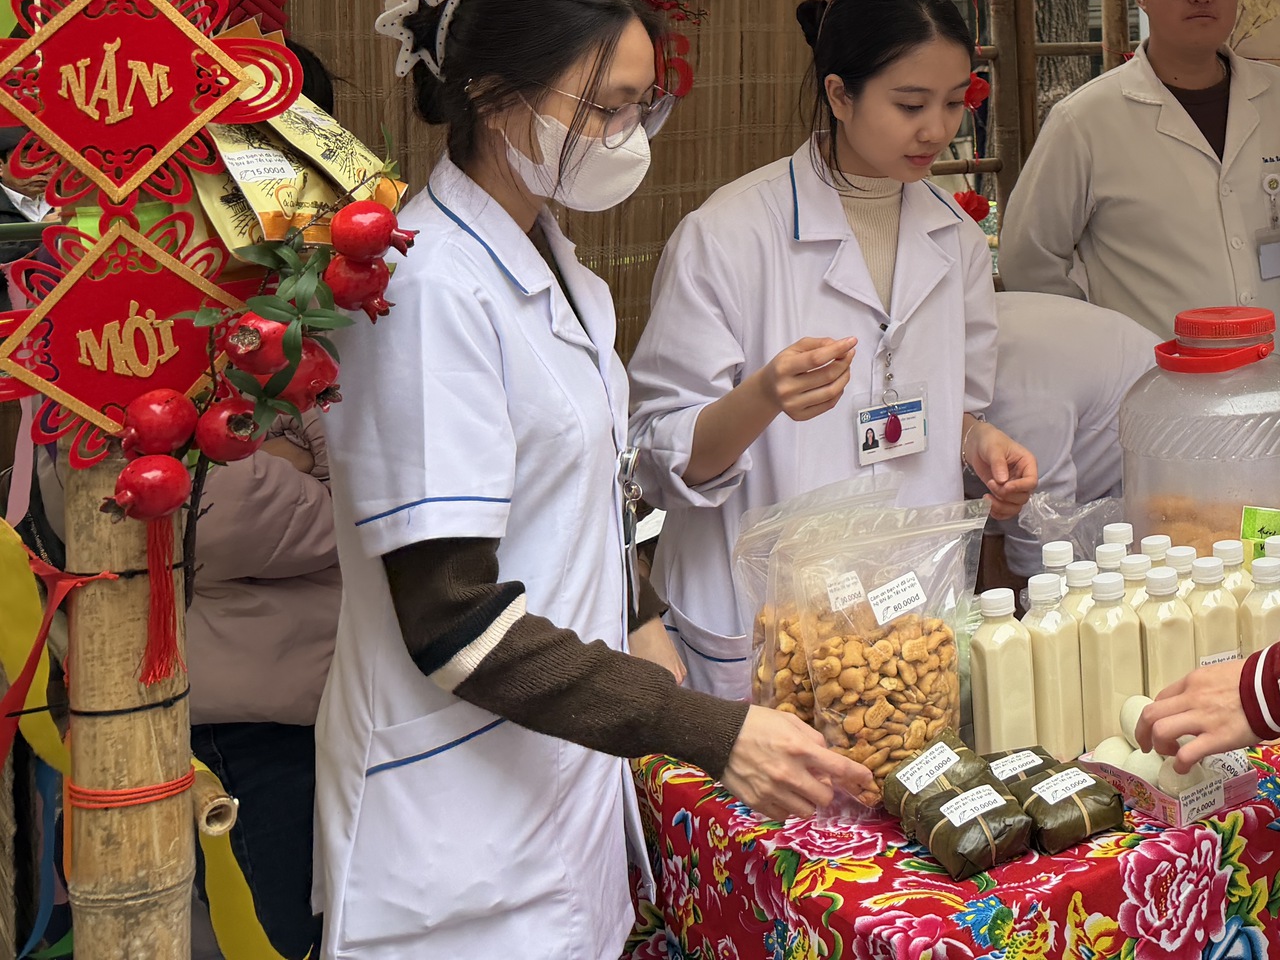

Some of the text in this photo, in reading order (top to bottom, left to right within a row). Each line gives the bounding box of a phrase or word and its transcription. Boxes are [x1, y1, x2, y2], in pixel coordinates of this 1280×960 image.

[58, 37, 174, 125] NĂM
[251, 167, 286, 175] 15.000đ
[75, 299, 180, 378] MỚI
[925, 757, 953, 778] 10.000đ
[1009, 759, 1036, 773] 10.000đ
[1062, 777, 1088, 794] 10.000đ
[970, 796, 998, 816] 10.000đ
[1195, 798, 1217, 813] 6.000đ
